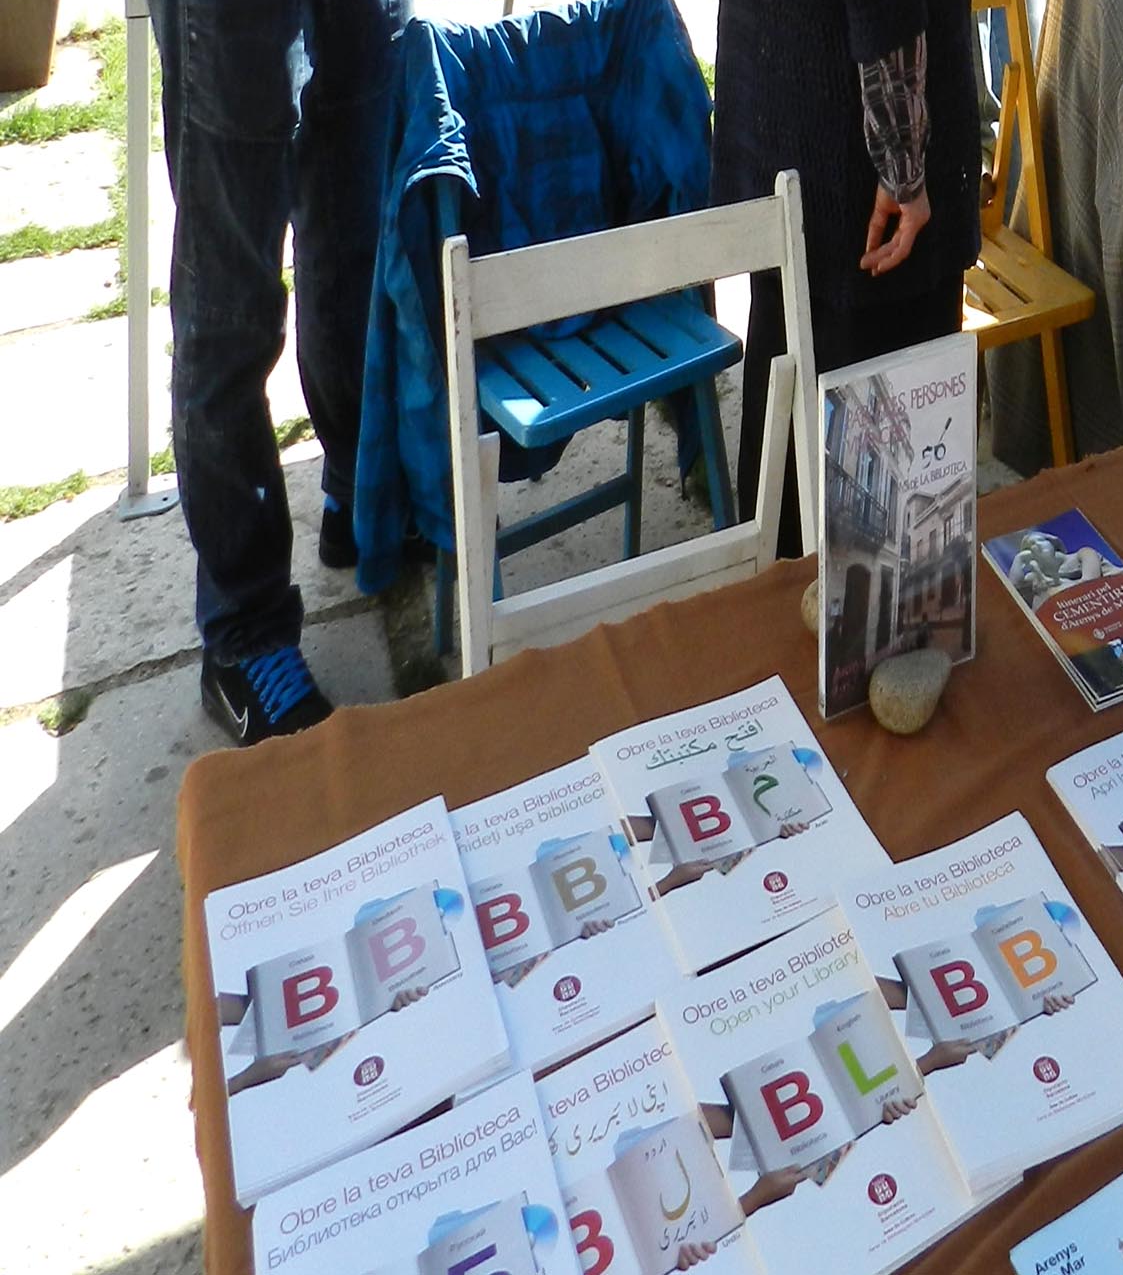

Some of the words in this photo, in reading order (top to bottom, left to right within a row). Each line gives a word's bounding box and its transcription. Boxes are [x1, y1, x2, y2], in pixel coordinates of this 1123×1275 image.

[911, 372, 966, 410] PERSONES
[930, 460, 968, 484] BIBLIOTECA
[1056, 590, 1096, 610] Itinerari
[1096, 581, 1112, 597] pel
[1061, 612, 1102, 631] d'Arenys
[1101, 605, 1115, 617] de
[616, 738, 656, 762] Obre
[658, 729, 674, 746] la
[675, 723, 709, 742] teva
[709, 694, 780, 731] Biblioteca
[724, 718, 764, 752] افتح
[1072, 765, 1109, 790] Obre
[1108, 756, 1122, 773] la
[1090, 776, 1119, 801] Apri
[465, 823, 481, 837] la
[484, 807, 521, 831] teva
[523, 770, 603, 814] Biblioteca
[538, 785, 607, 824] biblioteci
[679, 794, 733, 844] B
[228, 894, 278, 921] Obre
[282, 881, 299, 901] la
[303, 869, 343, 894] teva
[347, 821, 435, 874] Biblioteca
[289, 897, 320, 918] Sie
[323, 875, 358, 903] Ihre
[361, 831, 449, 885] Bibliothek
[551, 856, 608, 914] B
[855, 890, 897, 909] Obre
[898, 883, 914, 898] la
[914, 871, 948, 892] teva
[949, 834, 1024, 880] Biblioteca
[883, 898, 921, 922] Abre
[923, 890, 941, 908] tu
[941, 859, 1017, 902] Biblioteca
[368, 915, 427, 984] B
[475, 891, 531, 951] B
[929, 959, 989, 1019] B
[998, 929, 1059, 990] B
[282, 964, 341, 1031] B
[682, 999, 729, 1026] Obre
[730, 986, 748, 1007] la
[749, 969, 787, 997] teva
[710, 1004, 761, 1037] Open
[763, 980, 800, 1015] your
[804, 947, 860, 990] Library
[837, 1039, 899, 1097] L
[548, 1086, 592, 1119] teva
[760, 1070, 824, 1143] B
[267, 1204, 383, 1271] Библиотека
[386, 1165, 462, 1211] открыта
[464, 1147, 499, 1177] для
[499, 1118, 539, 1154] Вас!
[279, 1195, 338, 1237] Obre
[342, 1182, 363, 1207] la
[367, 1162, 415, 1193] teva
[418, 1105, 522, 1172] Biblioteca
[1034, 1241, 1079, 1275] Arenys
[1060, 1255, 1088, 1275] Mar
